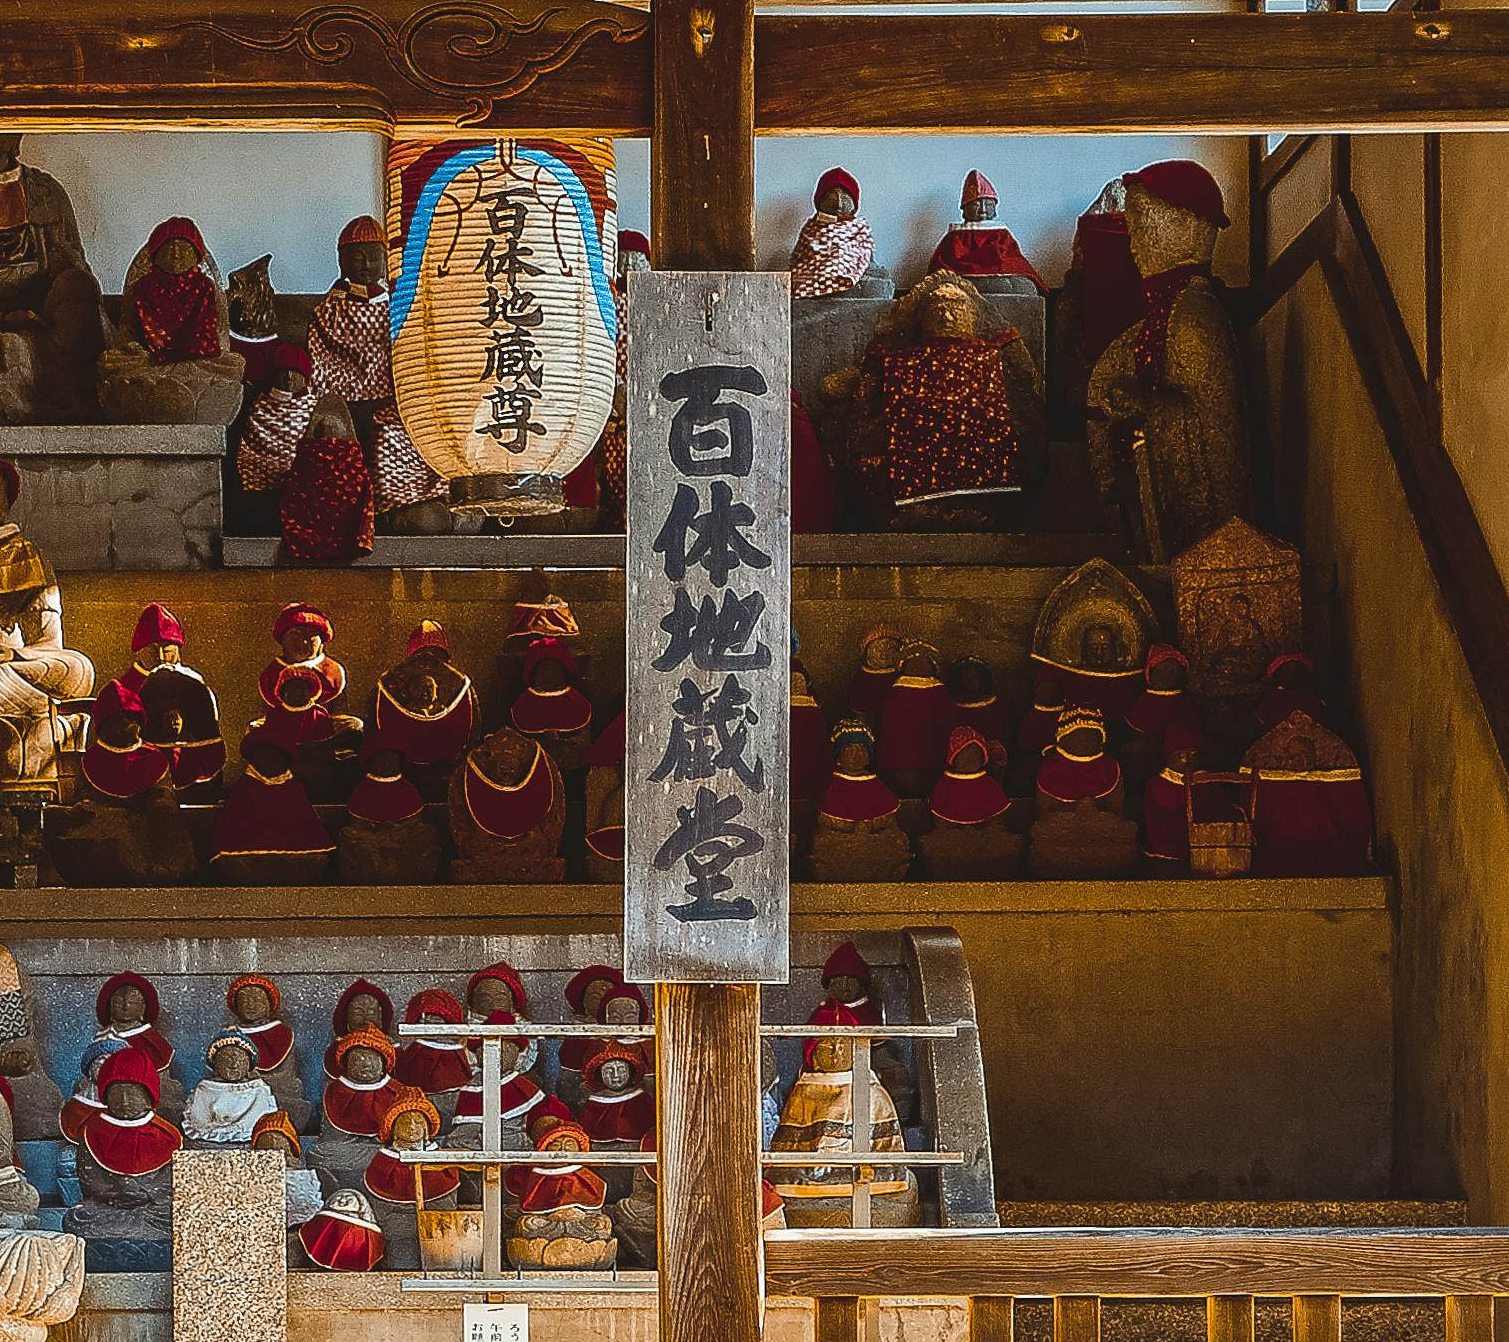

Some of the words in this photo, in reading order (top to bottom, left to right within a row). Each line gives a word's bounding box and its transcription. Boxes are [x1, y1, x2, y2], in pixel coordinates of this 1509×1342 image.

[473, 187, 547, 455] 百体地蔵尊
[650, 364, 772, 923] 百体地蔵堂
